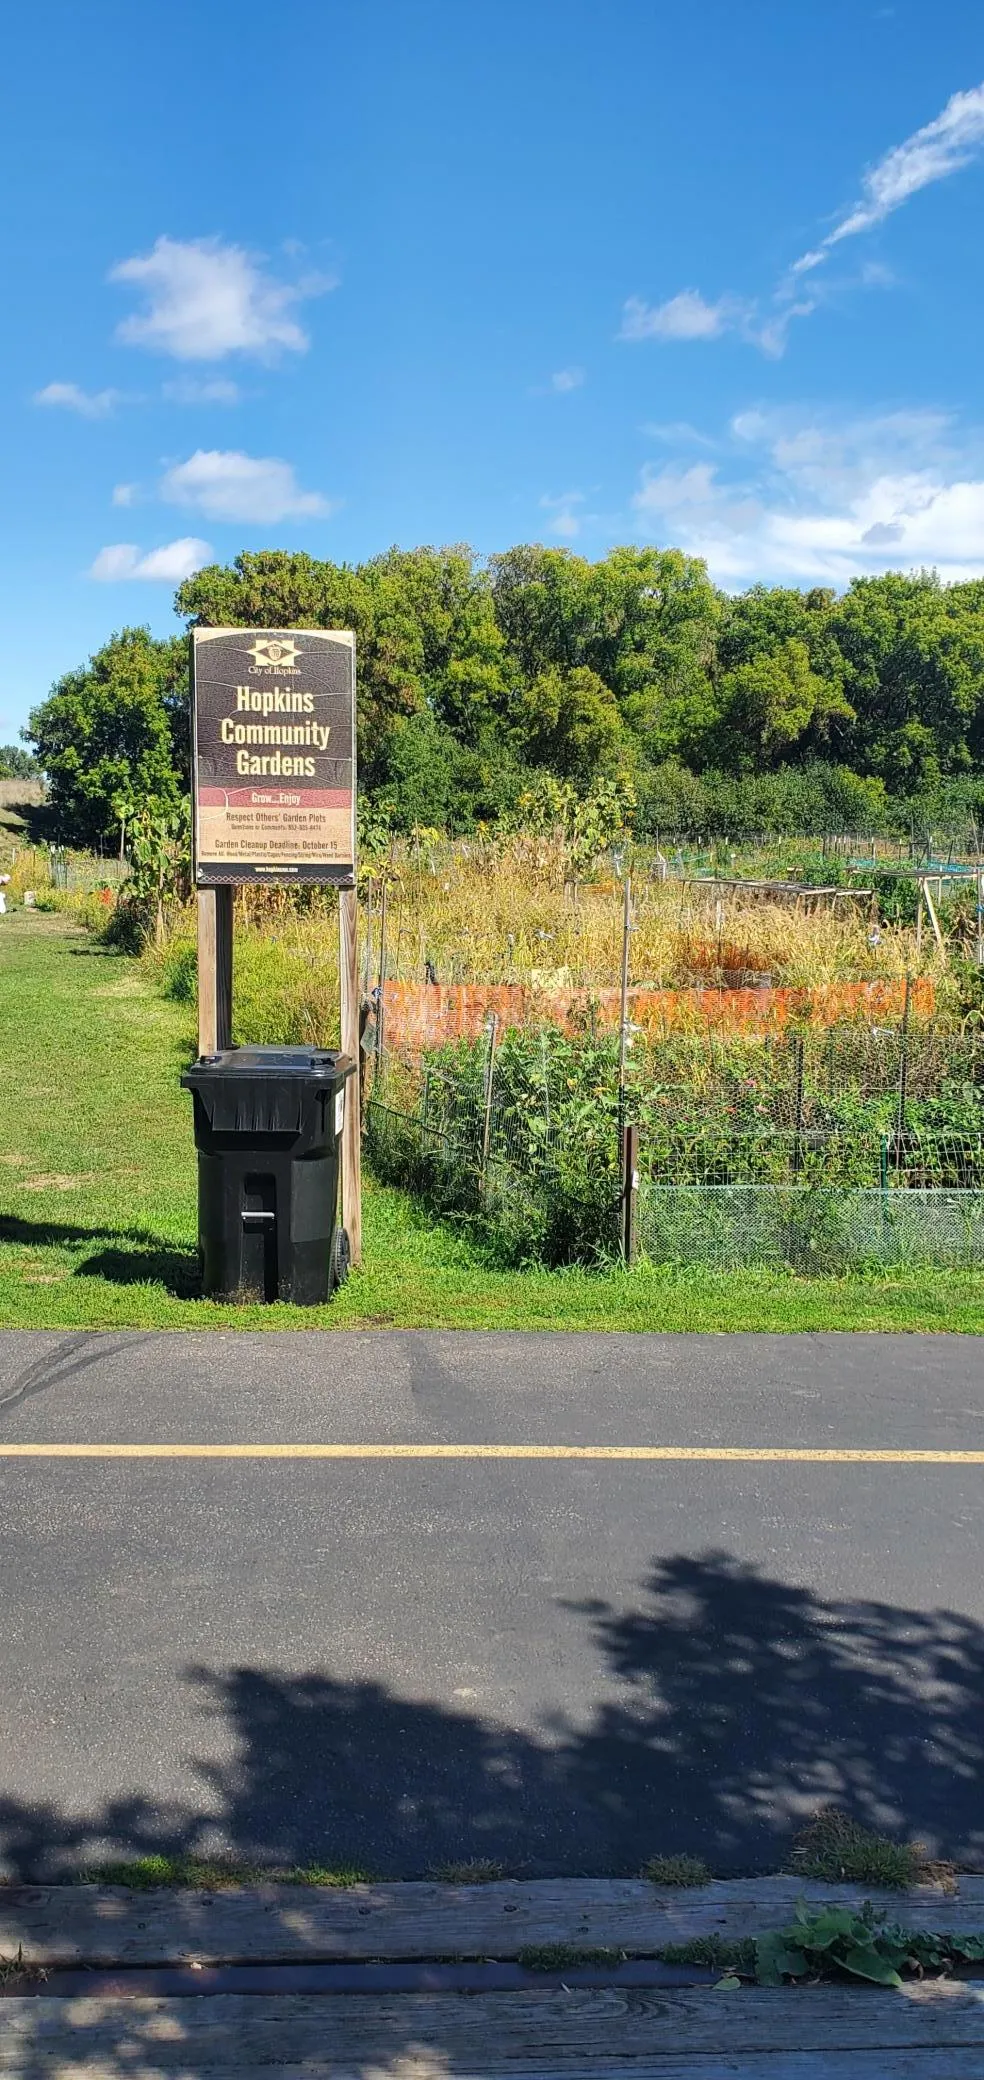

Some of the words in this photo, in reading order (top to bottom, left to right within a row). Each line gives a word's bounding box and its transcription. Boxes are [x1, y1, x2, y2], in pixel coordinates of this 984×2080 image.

[248, 666, 263, 676] City
[264, 666, 273, 675] of
[273, 666, 301, 677] Hopkins
[237, 686, 314, 717] Hopkins
[221, 718, 330, 751] Community
[236, 750, 316, 777] Gardens
[226, 812, 254, 822] Respect
[255, 812, 281, 822] Others'
[283, 813, 307, 823] Garden
[308, 814, 326, 823] Plots
[214, 839, 239, 849] Garden
[240, 840, 268, 850] Cleanup
[302, 841, 328, 850] October
[330, 841, 338, 850] 15
